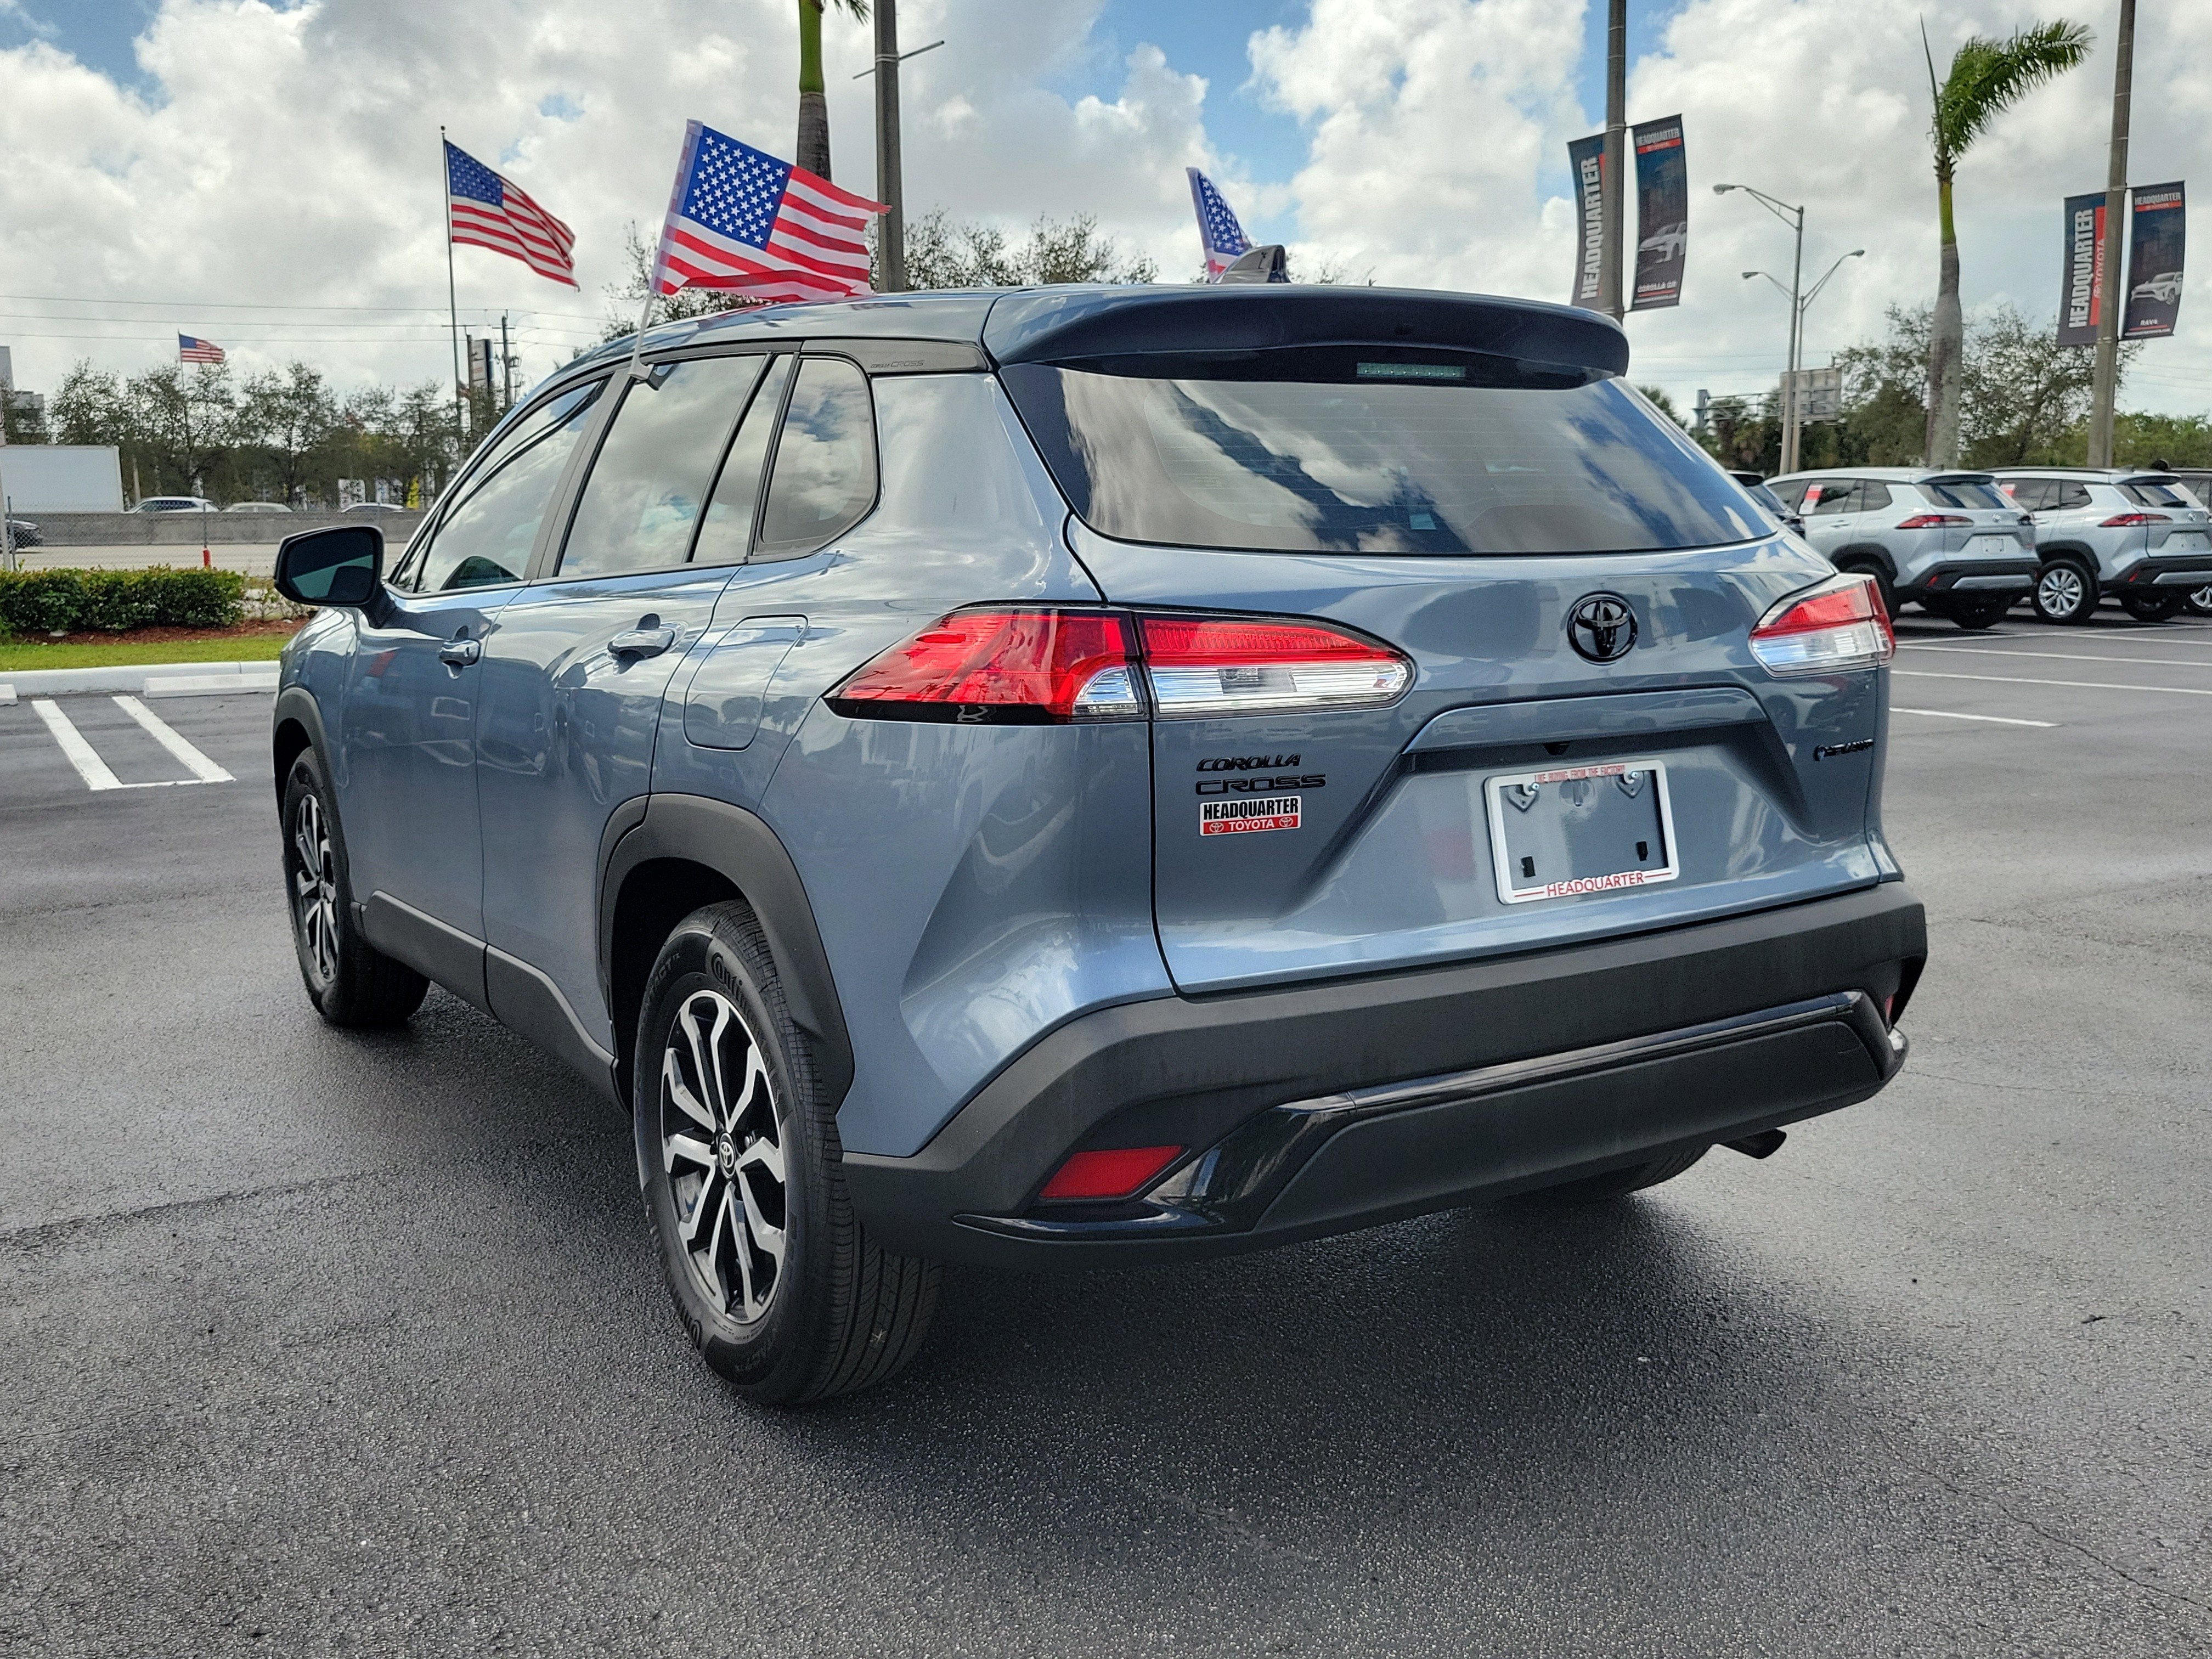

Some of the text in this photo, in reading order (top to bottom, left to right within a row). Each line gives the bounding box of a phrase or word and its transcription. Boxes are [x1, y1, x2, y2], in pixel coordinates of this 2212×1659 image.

[2135, 192, 2181, 206] HEADQUARTER
[1581, 156, 1604, 300] HEADQUARTER
[2068, 208, 2094, 328] HEADQUARTER
[1196, 753, 1301, 772] COROLLA
[1195, 774, 1326, 795] CROSS
[1203, 798, 1298, 820] HEADQUARTER
[1228, 819, 1274, 832] TOYOTA
[1546, 872, 1644, 896] HEADQUARTER
